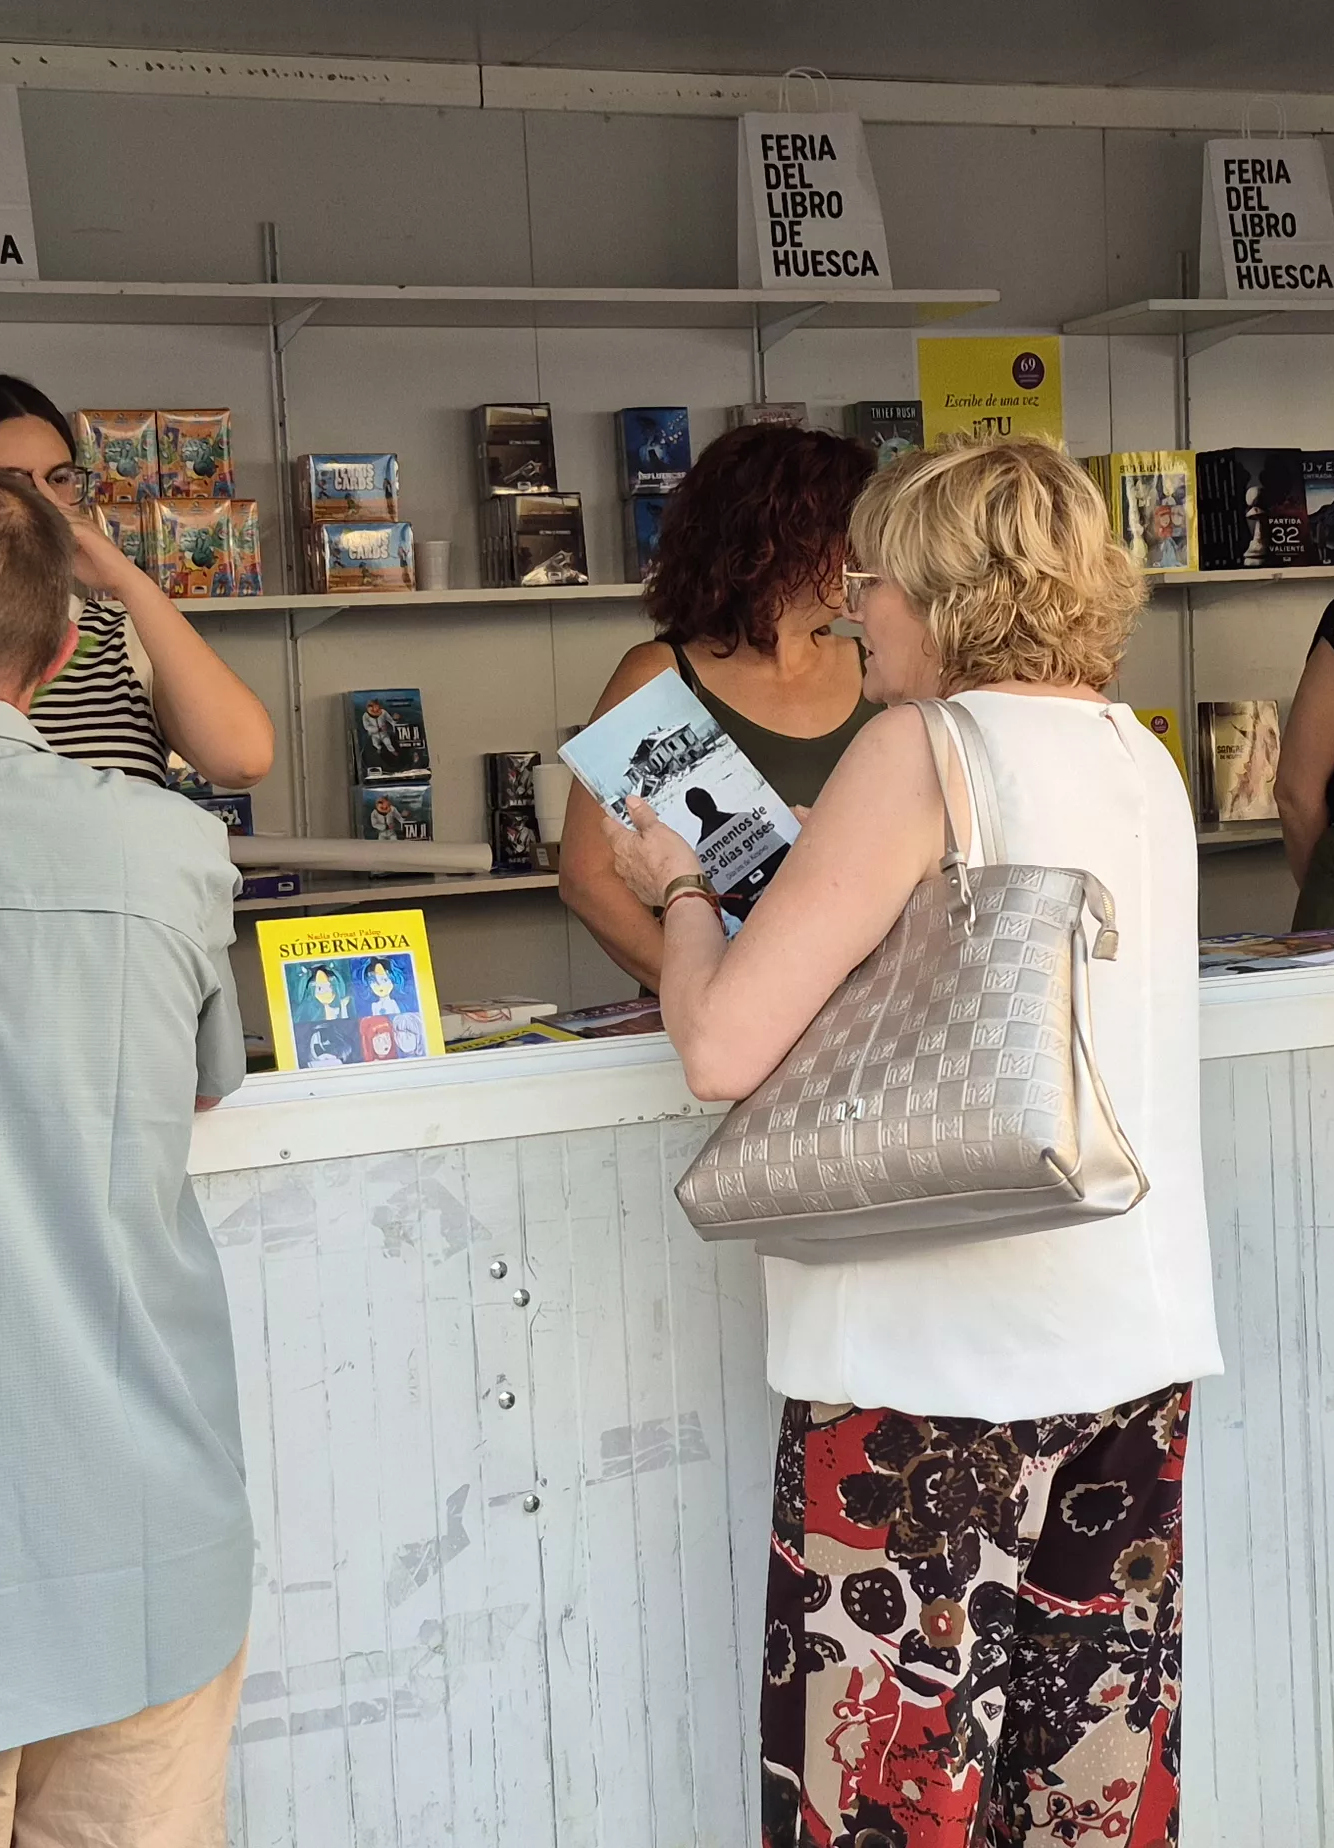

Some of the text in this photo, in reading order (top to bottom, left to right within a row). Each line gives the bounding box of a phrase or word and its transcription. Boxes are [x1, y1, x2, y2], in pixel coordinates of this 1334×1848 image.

[761, 134, 837, 161] FERIA
[764, 162, 813, 190] DEL
[1224, 159, 1291, 184] FERIA
[767, 190, 843, 219] LIBRO
[1225, 186, 1269, 211] DEL
[770, 220, 803, 248] DE
[1229, 212, 1297, 238] LIBRO
[773, 250, 879, 277] HUESCA
[1232, 239, 1263, 263] DE
[1236, 264, 1334, 289] HUESCA
[1020, 357, 1036, 372] 69
[871, 407, 916, 419] THIEF RUSH
[945, 393, 1039, 408] Escribe de una vez
[334, 476, 374, 491] CARDS
[1271, 526, 1301, 544] 32
[348, 545, 388, 559] CARDS
[397, 726, 410, 740] TAI
[404, 823, 417, 838] TAI
[699, 805, 767, 863] agmentos de
[719, 820, 775, 868] días grises
[279, 934, 410, 959] SÚPERNADYA
[307, 931, 330, 941] Nadia
